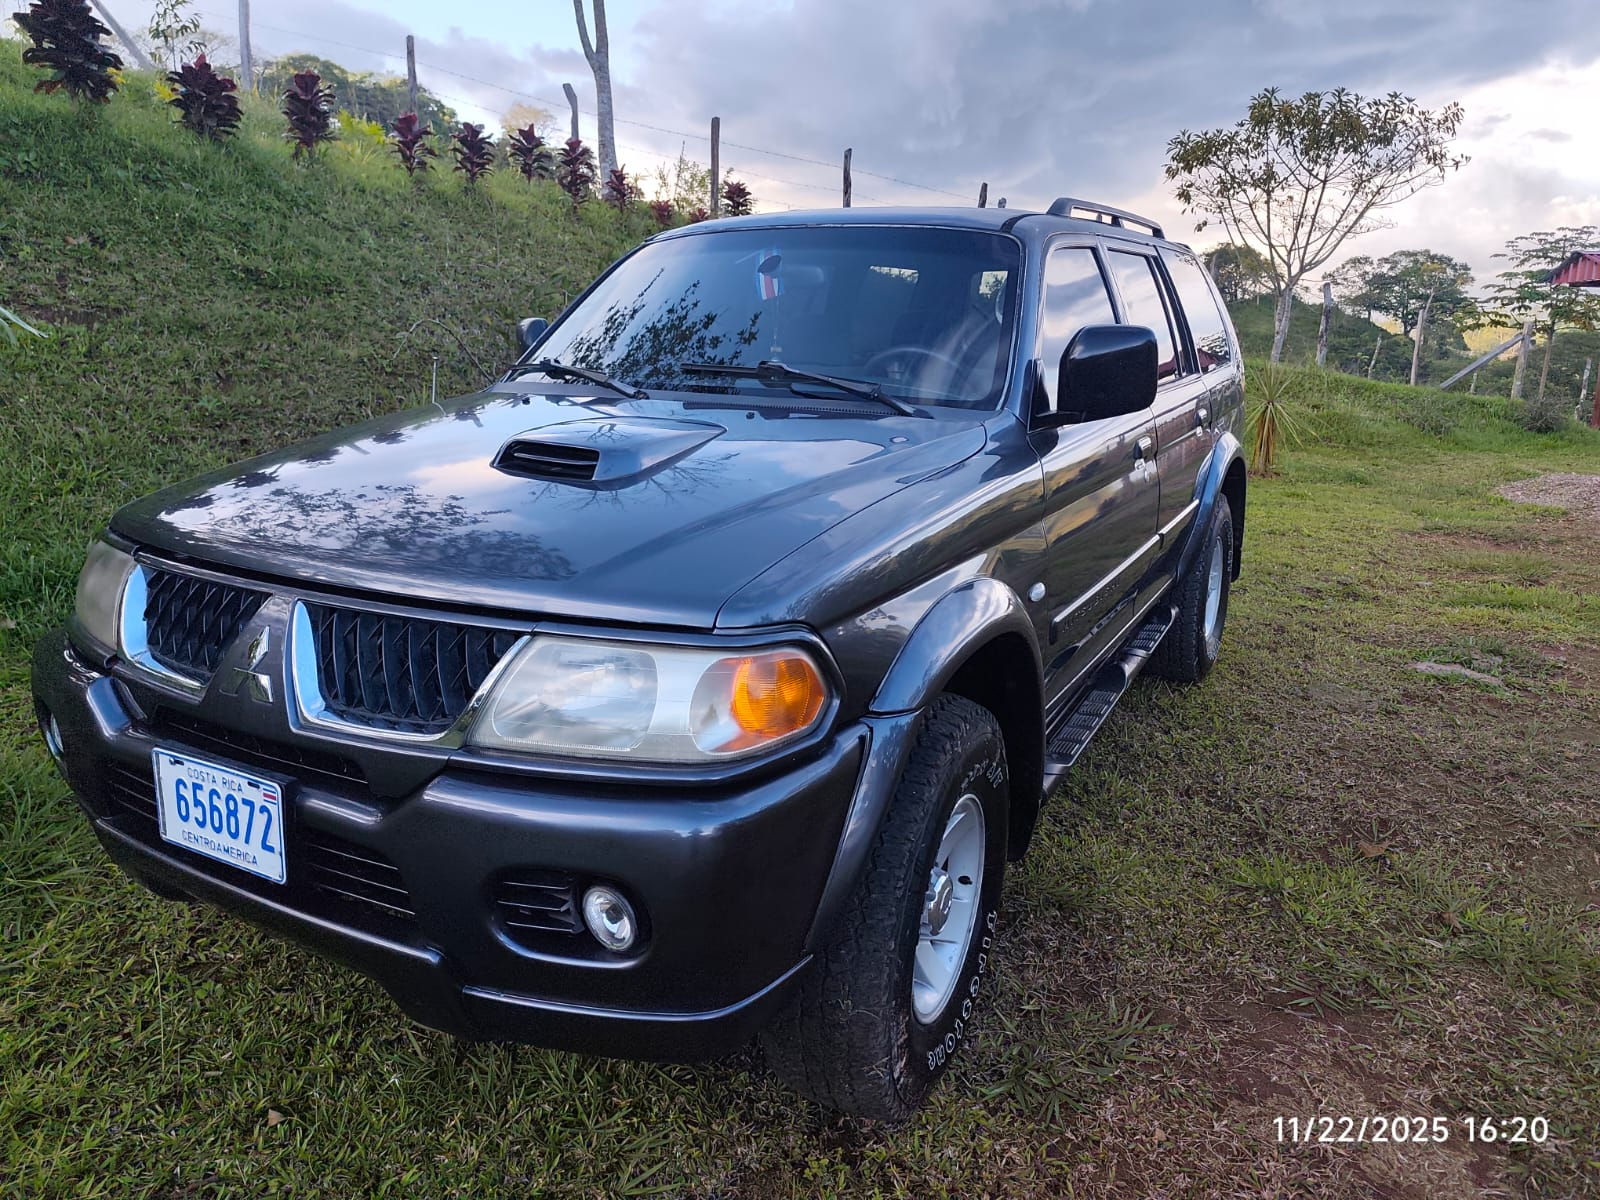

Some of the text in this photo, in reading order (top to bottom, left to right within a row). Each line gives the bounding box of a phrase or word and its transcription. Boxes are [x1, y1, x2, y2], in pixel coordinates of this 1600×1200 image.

[187, 767, 243, 793] COSTA RICA
[175, 778, 275, 854] 656872
[181, 830, 258, 866] CENTROAMERICA
